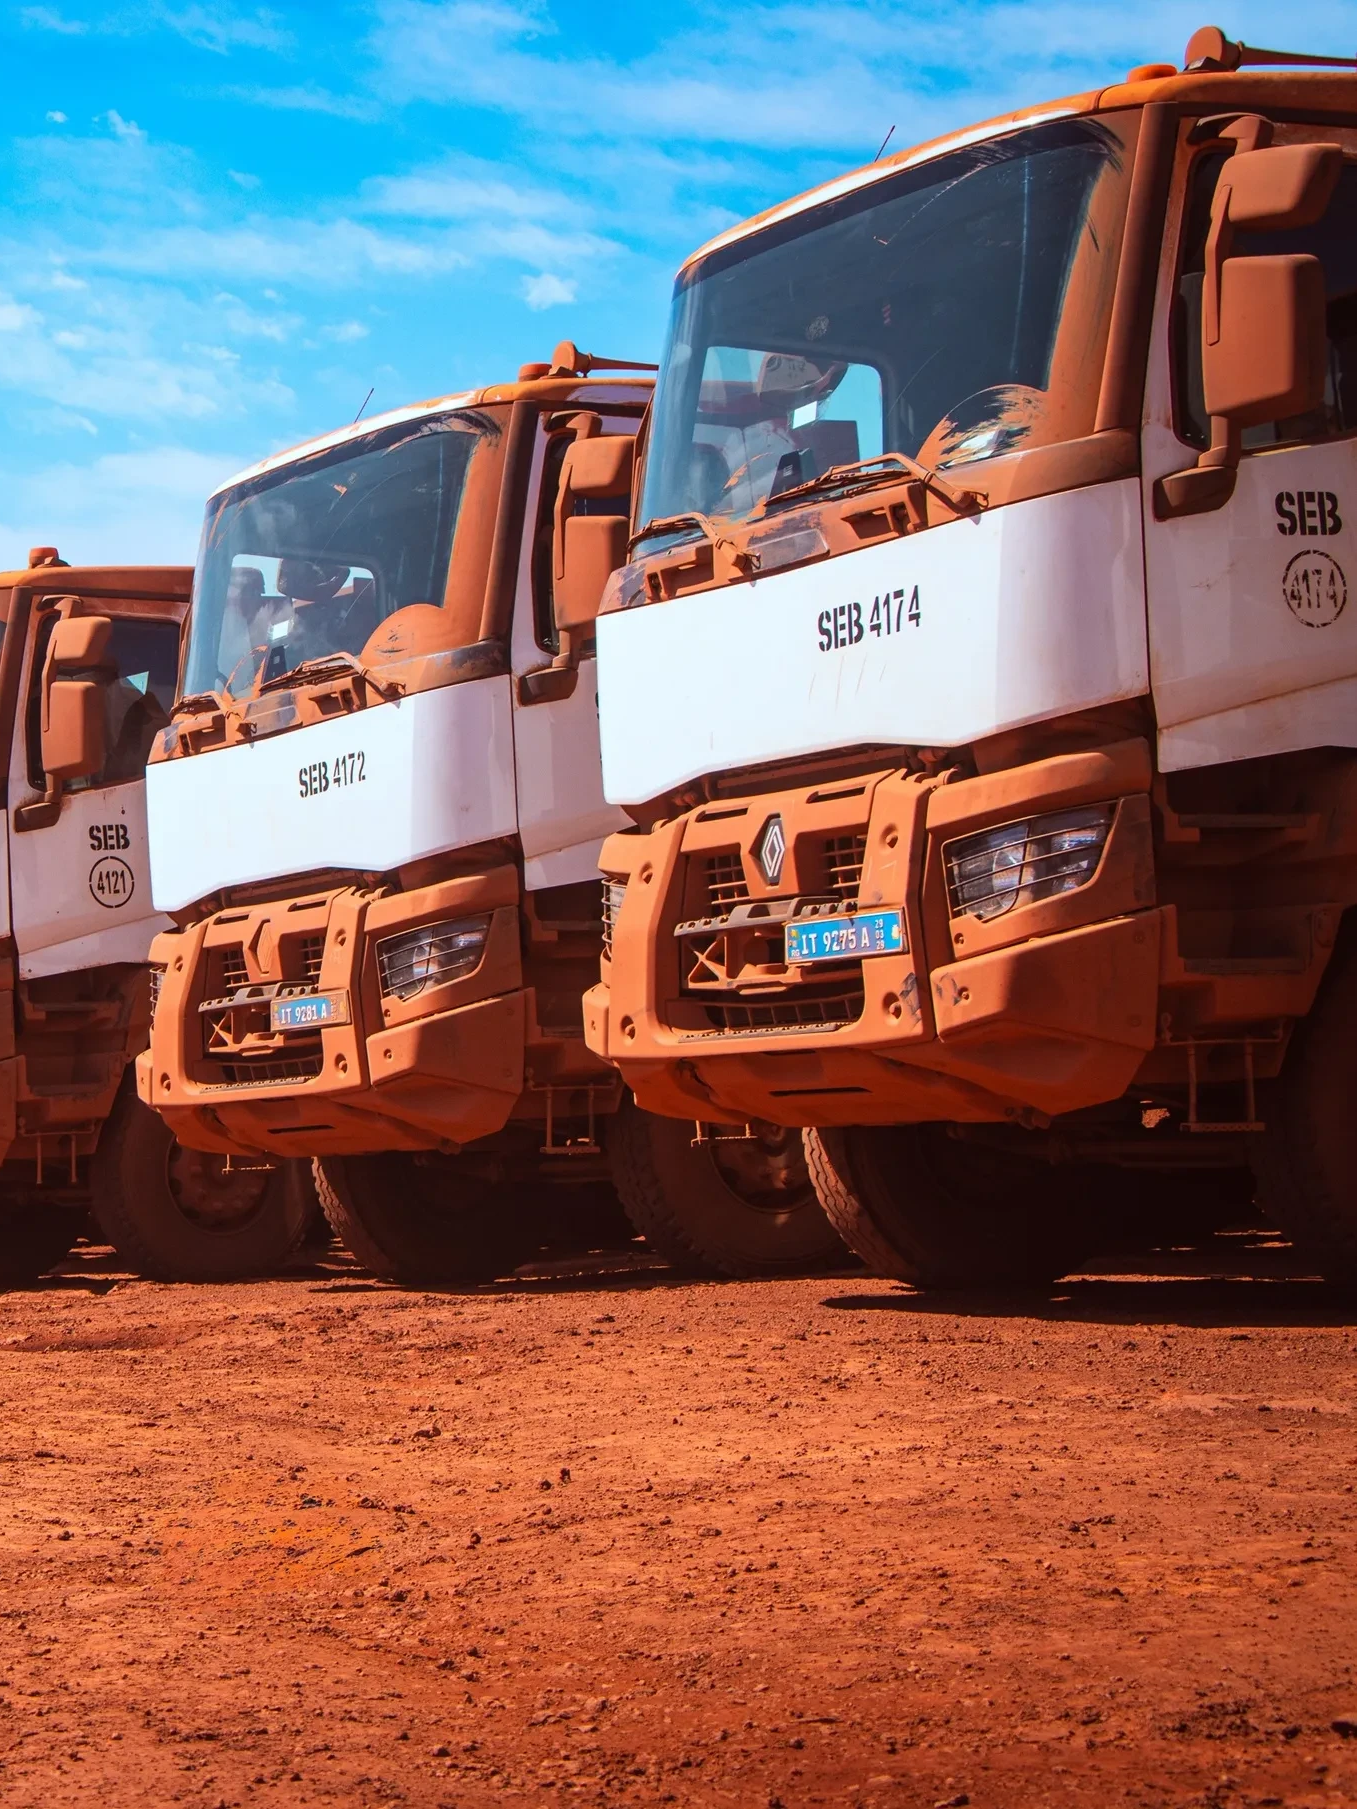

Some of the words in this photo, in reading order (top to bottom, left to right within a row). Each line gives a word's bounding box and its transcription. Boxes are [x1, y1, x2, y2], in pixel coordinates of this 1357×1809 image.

[1275, 491, 1343, 536] SEB
[1290, 568, 1338, 609] 4174
[818, 602, 864, 652] SEB
[869, 584, 922, 638] 4174
[299, 761, 330, 798] SEB
[333, 750, 366, 788] 4172
[89, 823, 131, 851] SEB
[97, 869, 126, 895] 4121
[822, 927, 857, 953] 9275
[861, 926, 871, 949] A
[295, 1004, 318, 1023] 9281
